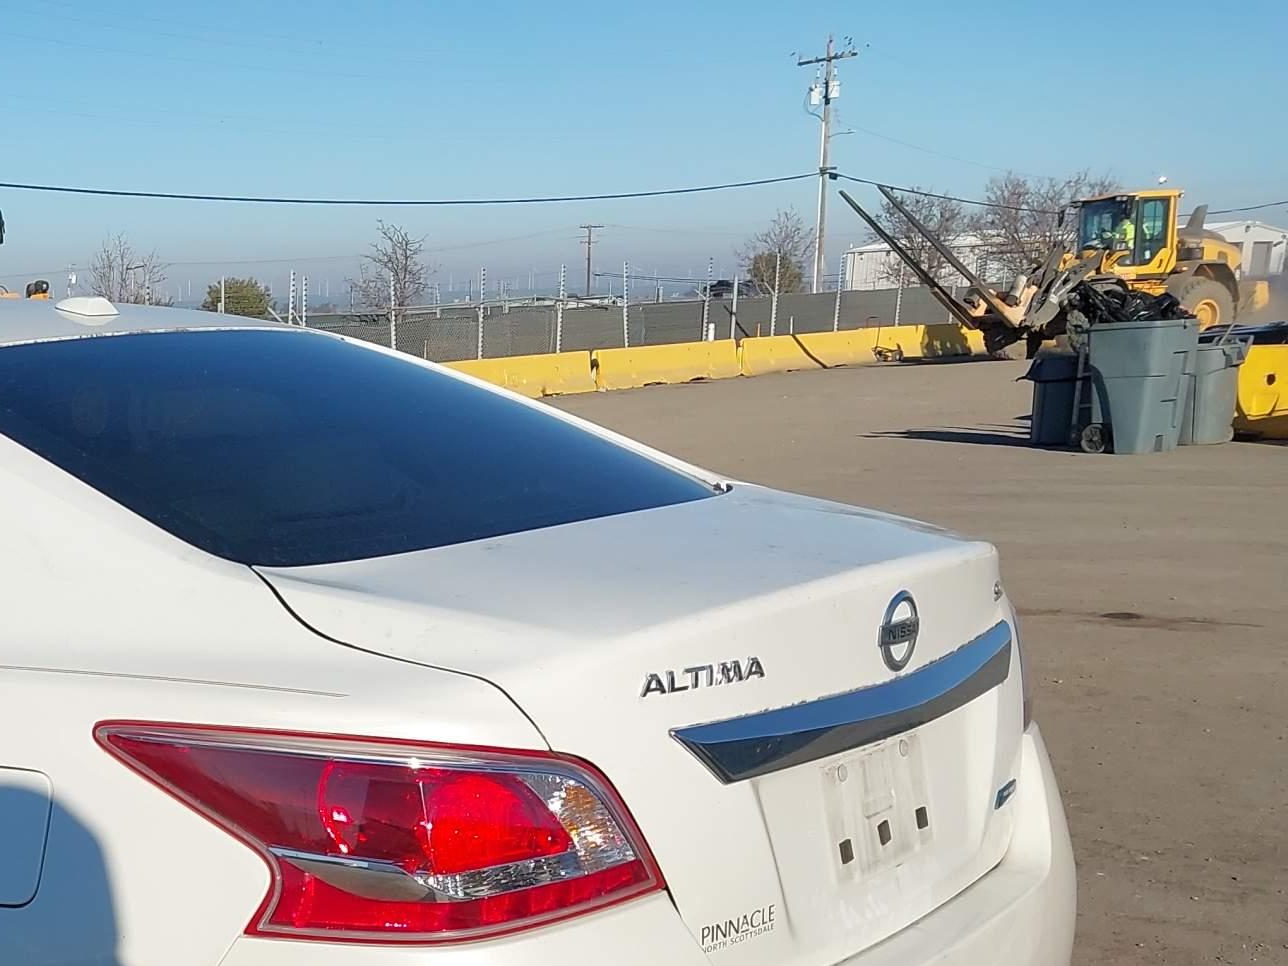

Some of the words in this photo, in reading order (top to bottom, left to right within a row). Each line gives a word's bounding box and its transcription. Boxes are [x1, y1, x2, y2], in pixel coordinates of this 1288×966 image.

[639, 656, 765, 698] ALTIMA
[701, 904, 775, 946] PINNACLE
[730, 922, 774, 946] SCOTTSDALE
